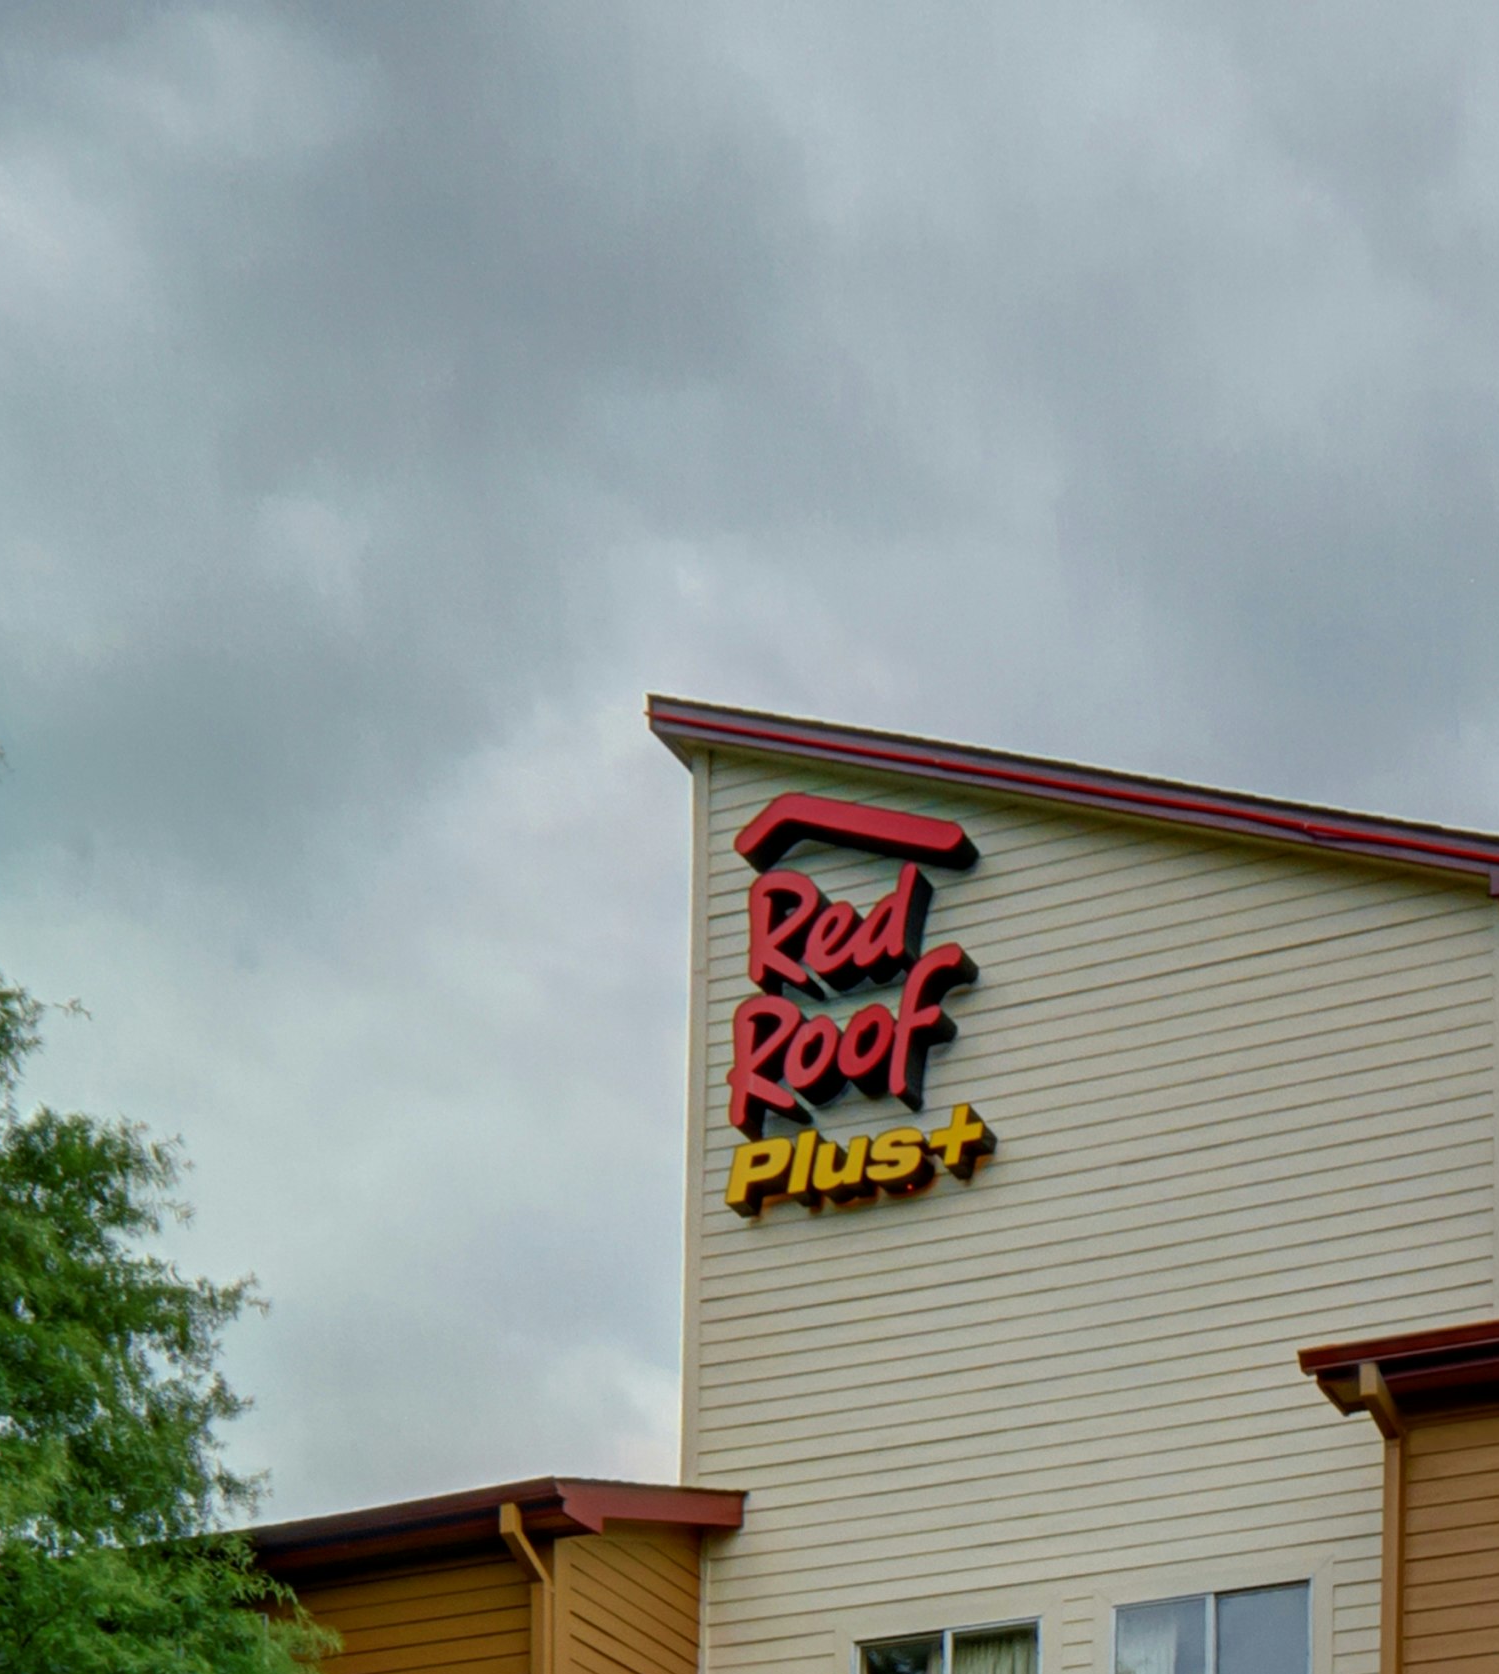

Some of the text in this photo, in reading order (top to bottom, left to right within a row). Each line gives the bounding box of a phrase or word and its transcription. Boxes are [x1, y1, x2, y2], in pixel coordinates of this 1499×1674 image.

[748, 861, 928, 990] Red
[727, 943, 972, 1132] Roof
[725, 1103, 990, 1208] Plus+
